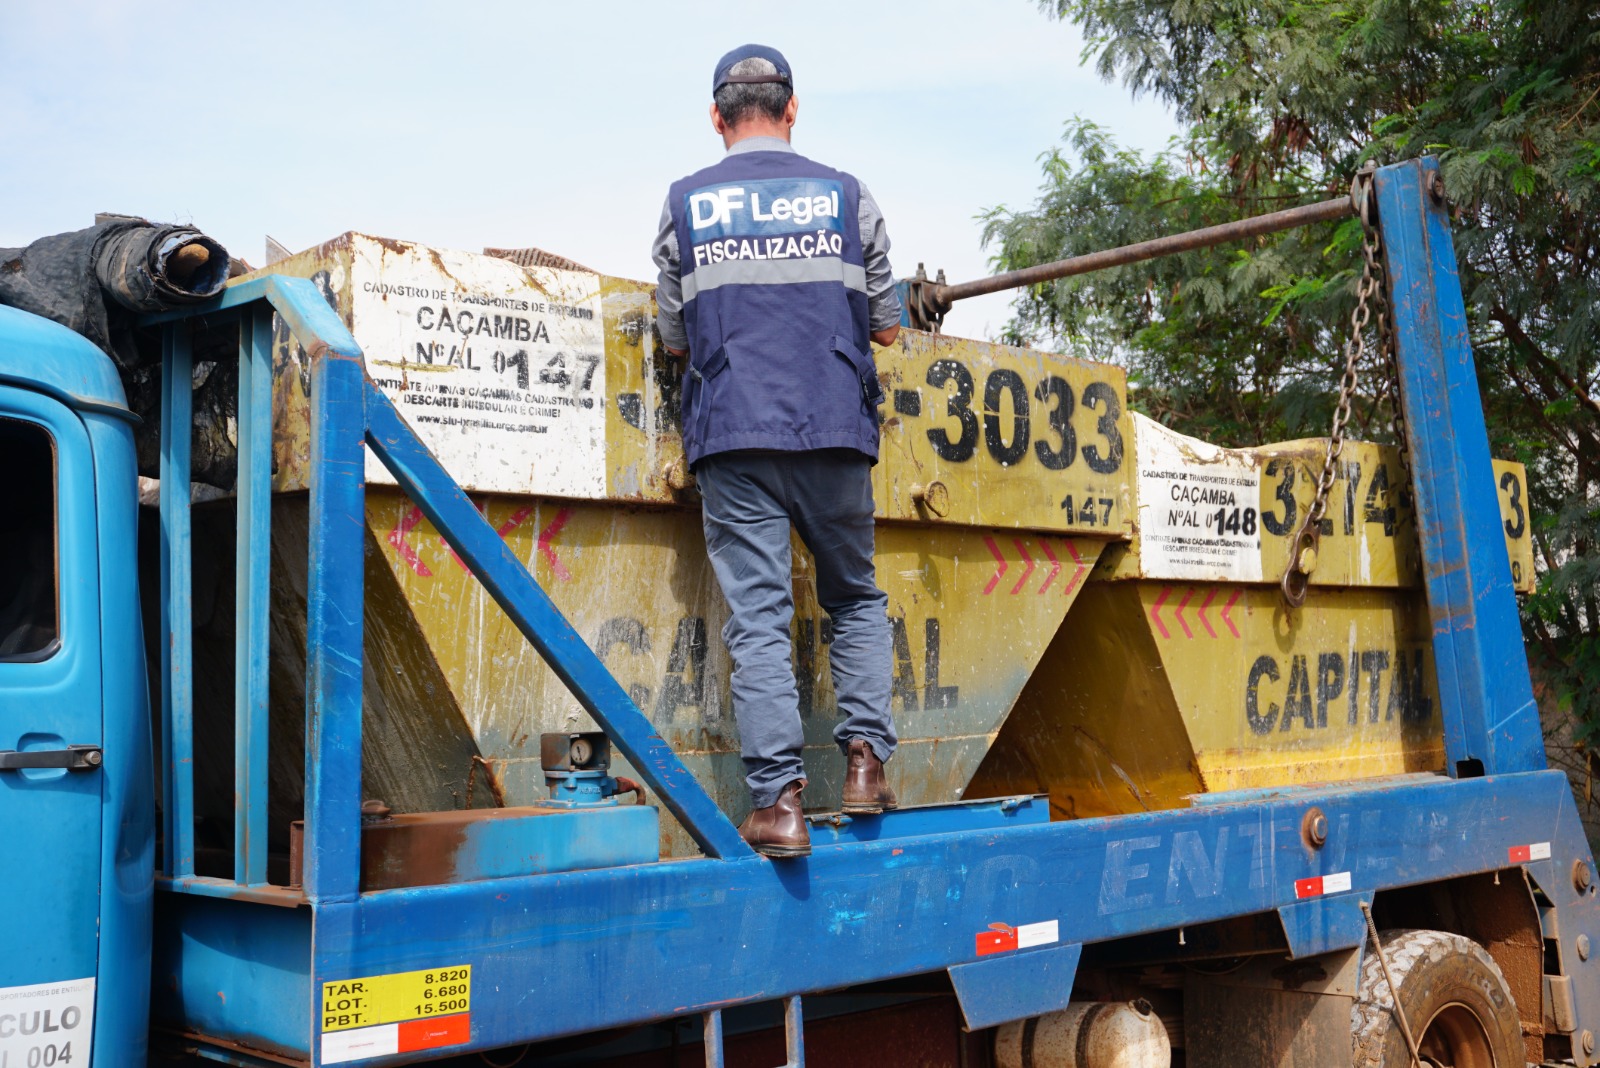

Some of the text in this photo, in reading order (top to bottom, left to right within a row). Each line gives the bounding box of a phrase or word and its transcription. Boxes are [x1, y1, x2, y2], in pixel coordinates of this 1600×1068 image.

[689, 187, 839, 231] DF Legal
[693, 229, 842, 267] FISCALIZAÇÃO
[363, 282, 429, 298] CADASTRO
[432, 289, 447, 301] DE
[531, 302, 545, 313] DE
[416, 305, 551, 344] CAÇAMBA
[492, 349, 601, 390] 0147
[1180, 472, 1188, 481] DE
[1060, 494, 1114, 527] 147
[1171, 484, 1236, 506] CAÇAMBA
[1205, 507, 1257, 536] 0148
[1245, 649, 1433, 736] CAPITAL
[325, 969, 468, 997] TAR. 8.820
[325, 984, 467, 1012] LOT. 6.680
[0, 1005, 82, 1038] CULO
[324, 999, 467, 1028] PBT. 15.500
[27, 1041, 73, 1068] 004
